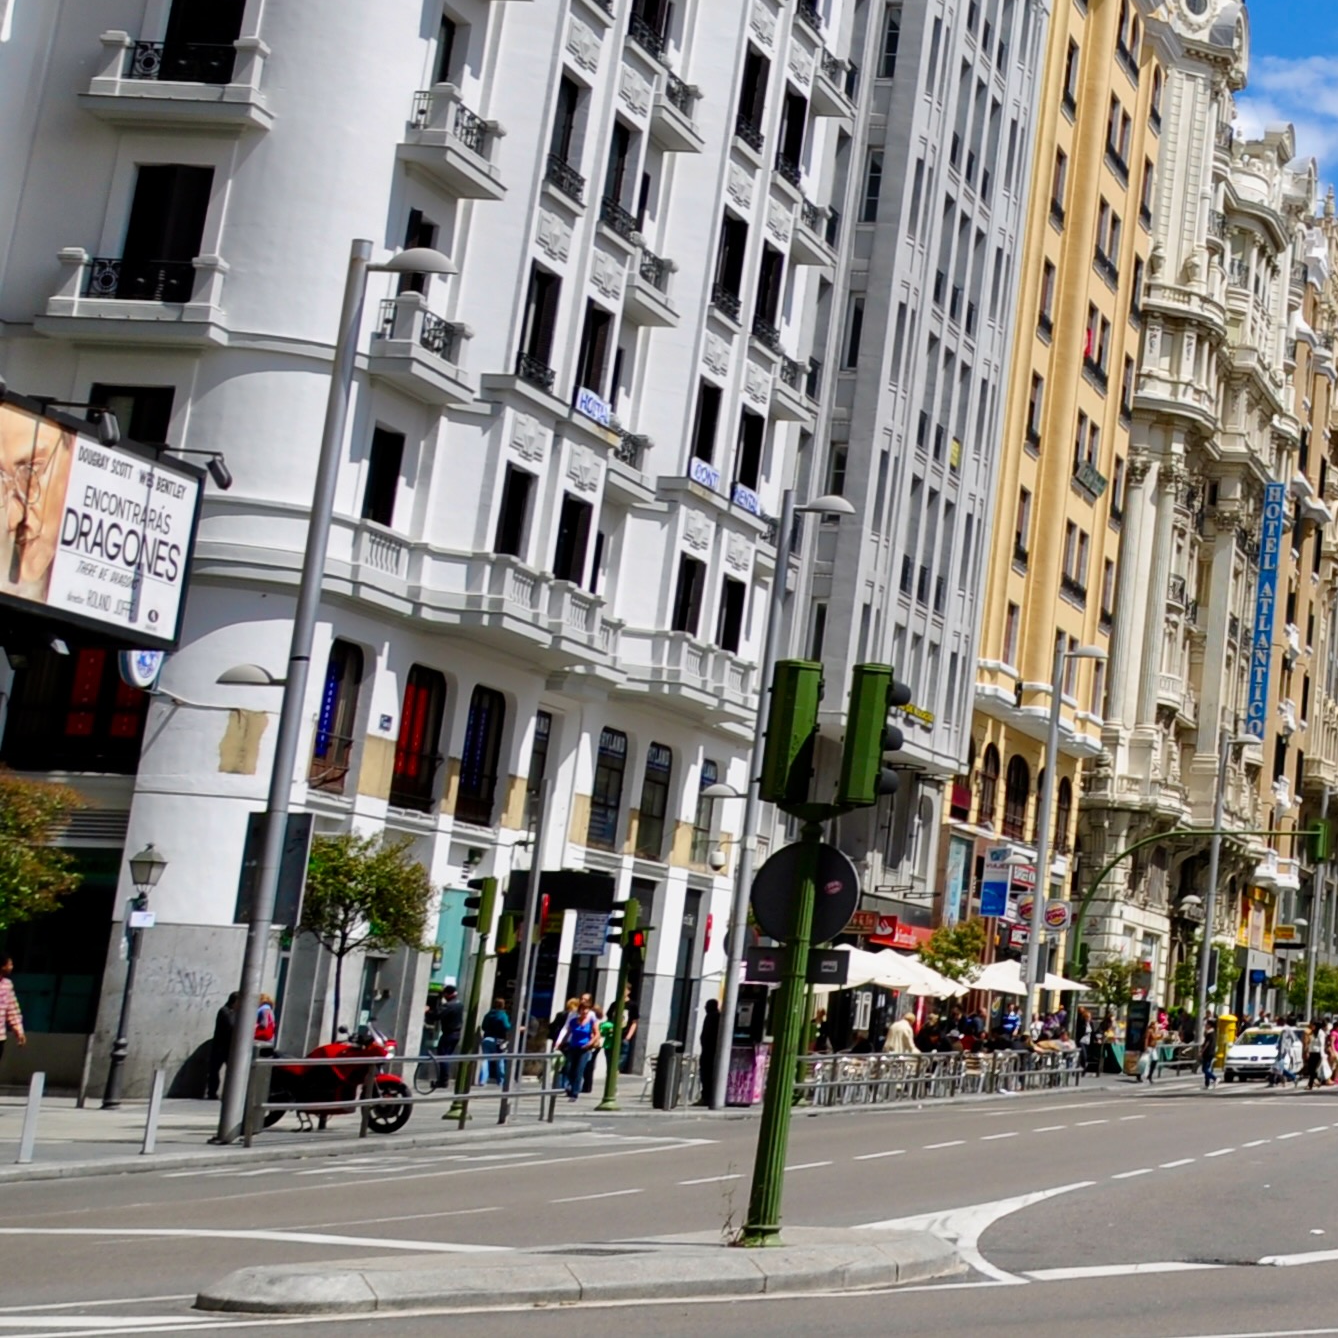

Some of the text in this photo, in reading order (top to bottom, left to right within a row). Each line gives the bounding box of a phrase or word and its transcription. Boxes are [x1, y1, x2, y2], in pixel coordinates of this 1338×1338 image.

[78, 446, 111, 473] DOUGRAY
[111, 458, 134, 480] SCOTT
[156, 477, 187, 500] BENTLEY
[84, 485, 172, 535] ENCONTRARÁS
[1262, 486, 1282, 570] HOTEL
[61, 507, 181, 582] DRAGONES
